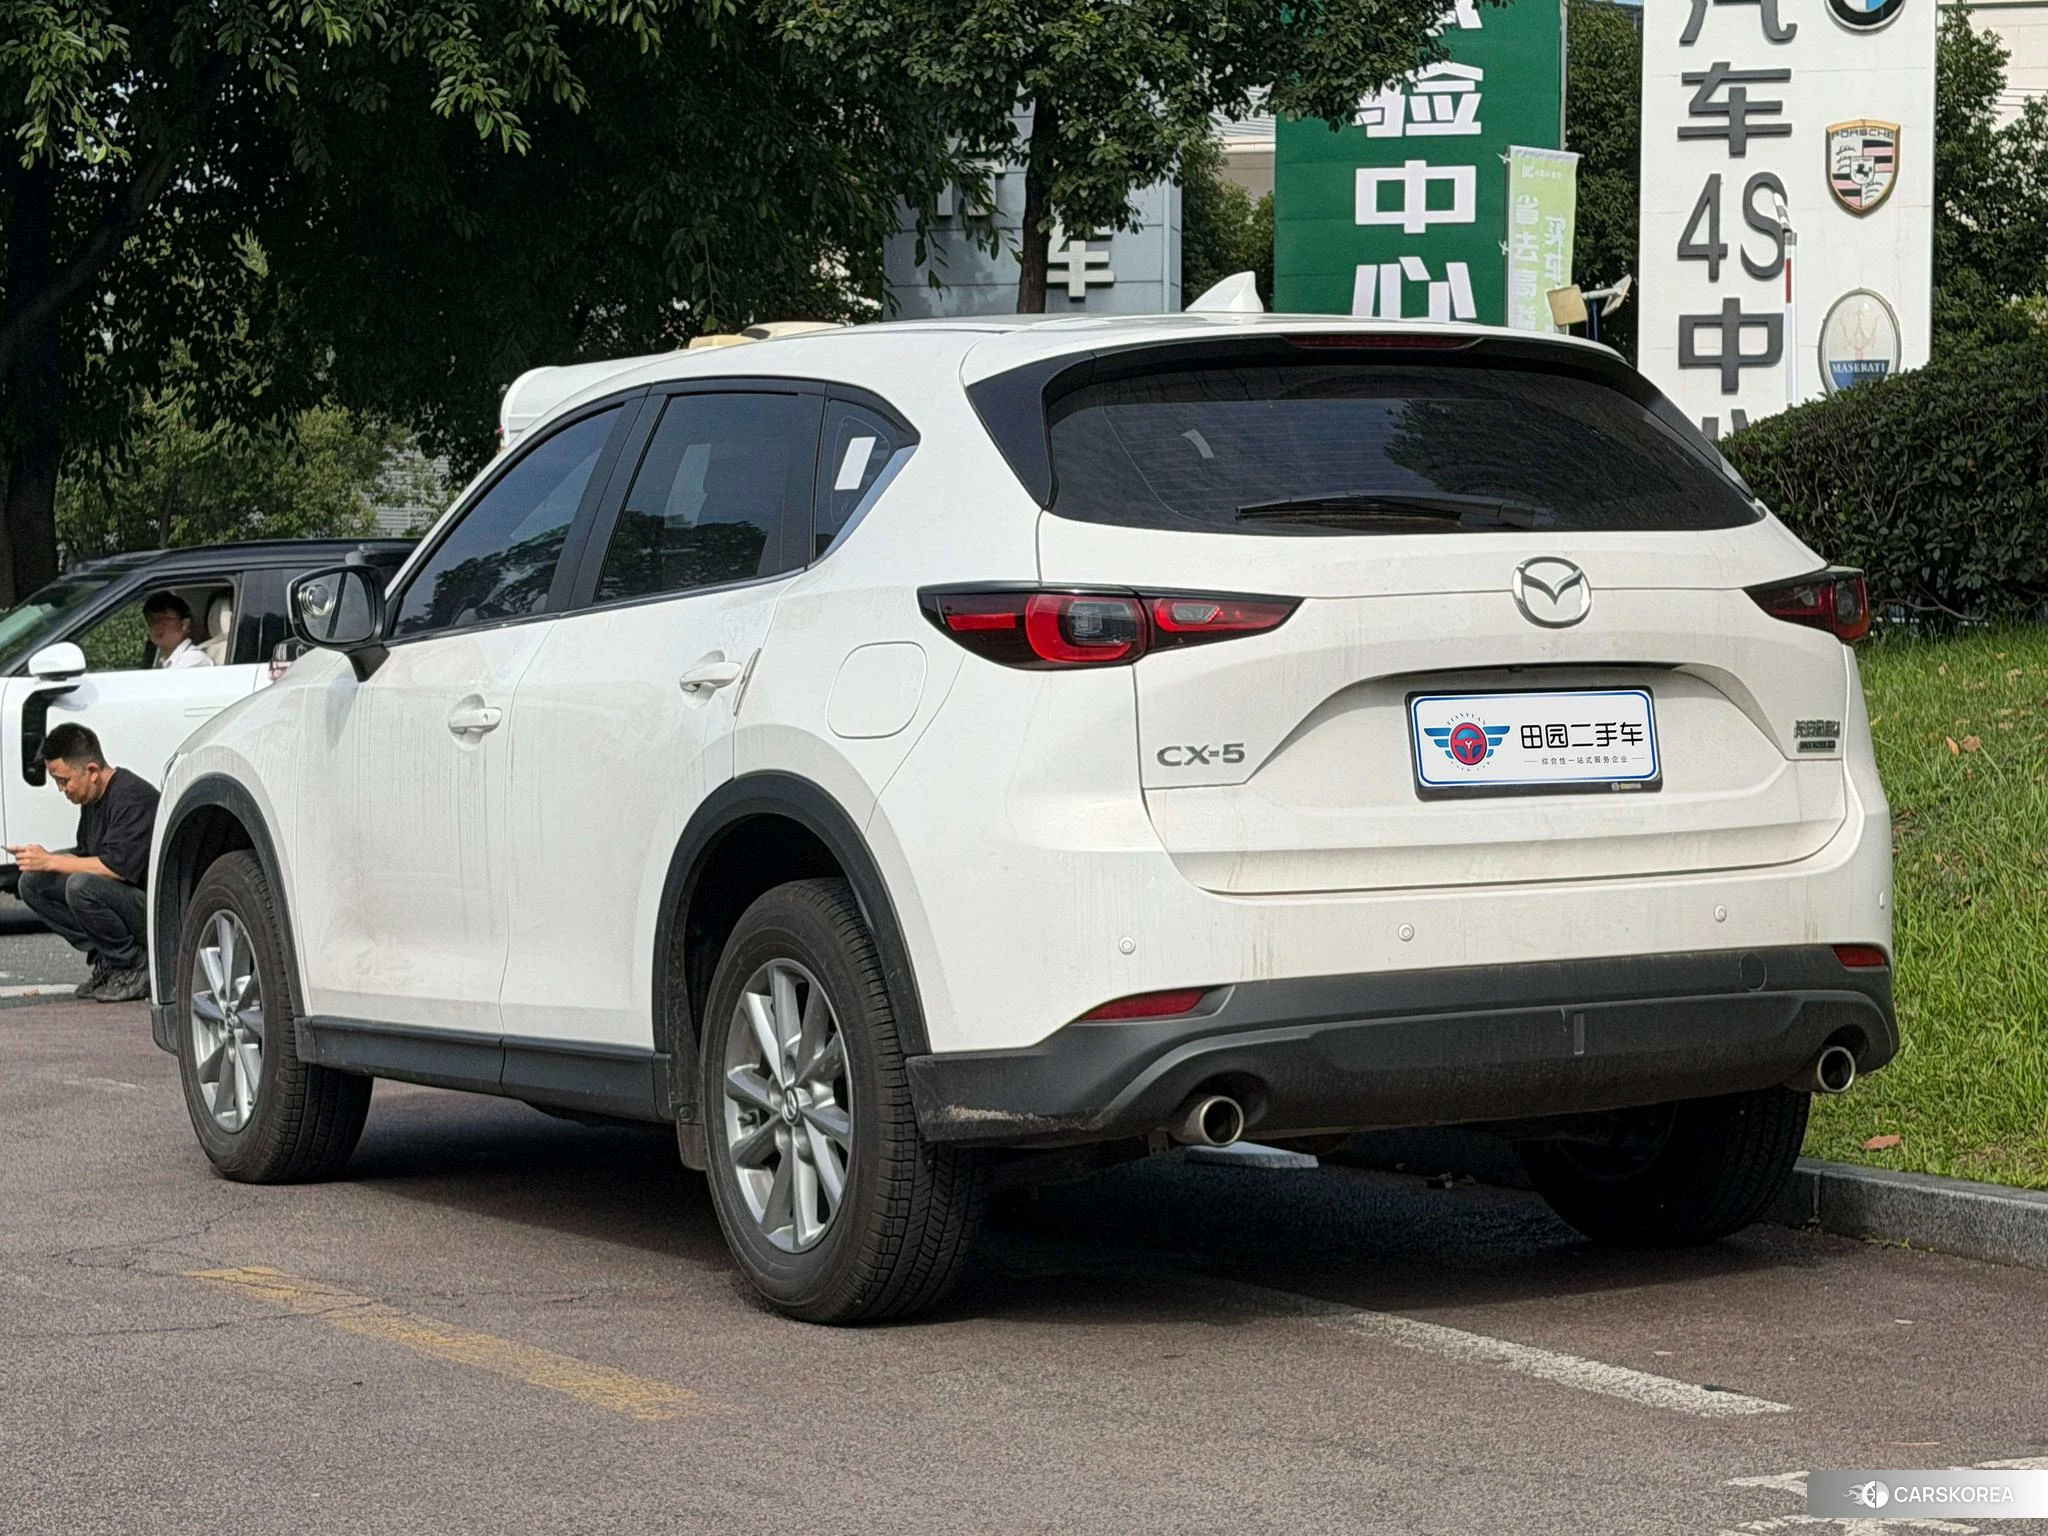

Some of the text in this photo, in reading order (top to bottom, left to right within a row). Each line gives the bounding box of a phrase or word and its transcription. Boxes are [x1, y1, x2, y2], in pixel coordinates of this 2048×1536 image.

[1831, 128, 1894, 140] PORSCHE
[1832, 362, 1885, 373] MASERATI
[1520, 722, 1643, 749] 田园二手车
[1157, 743, 1245, 767] CX-5
[1541, 756, 1628, 766] 综合性一站式服务企业
